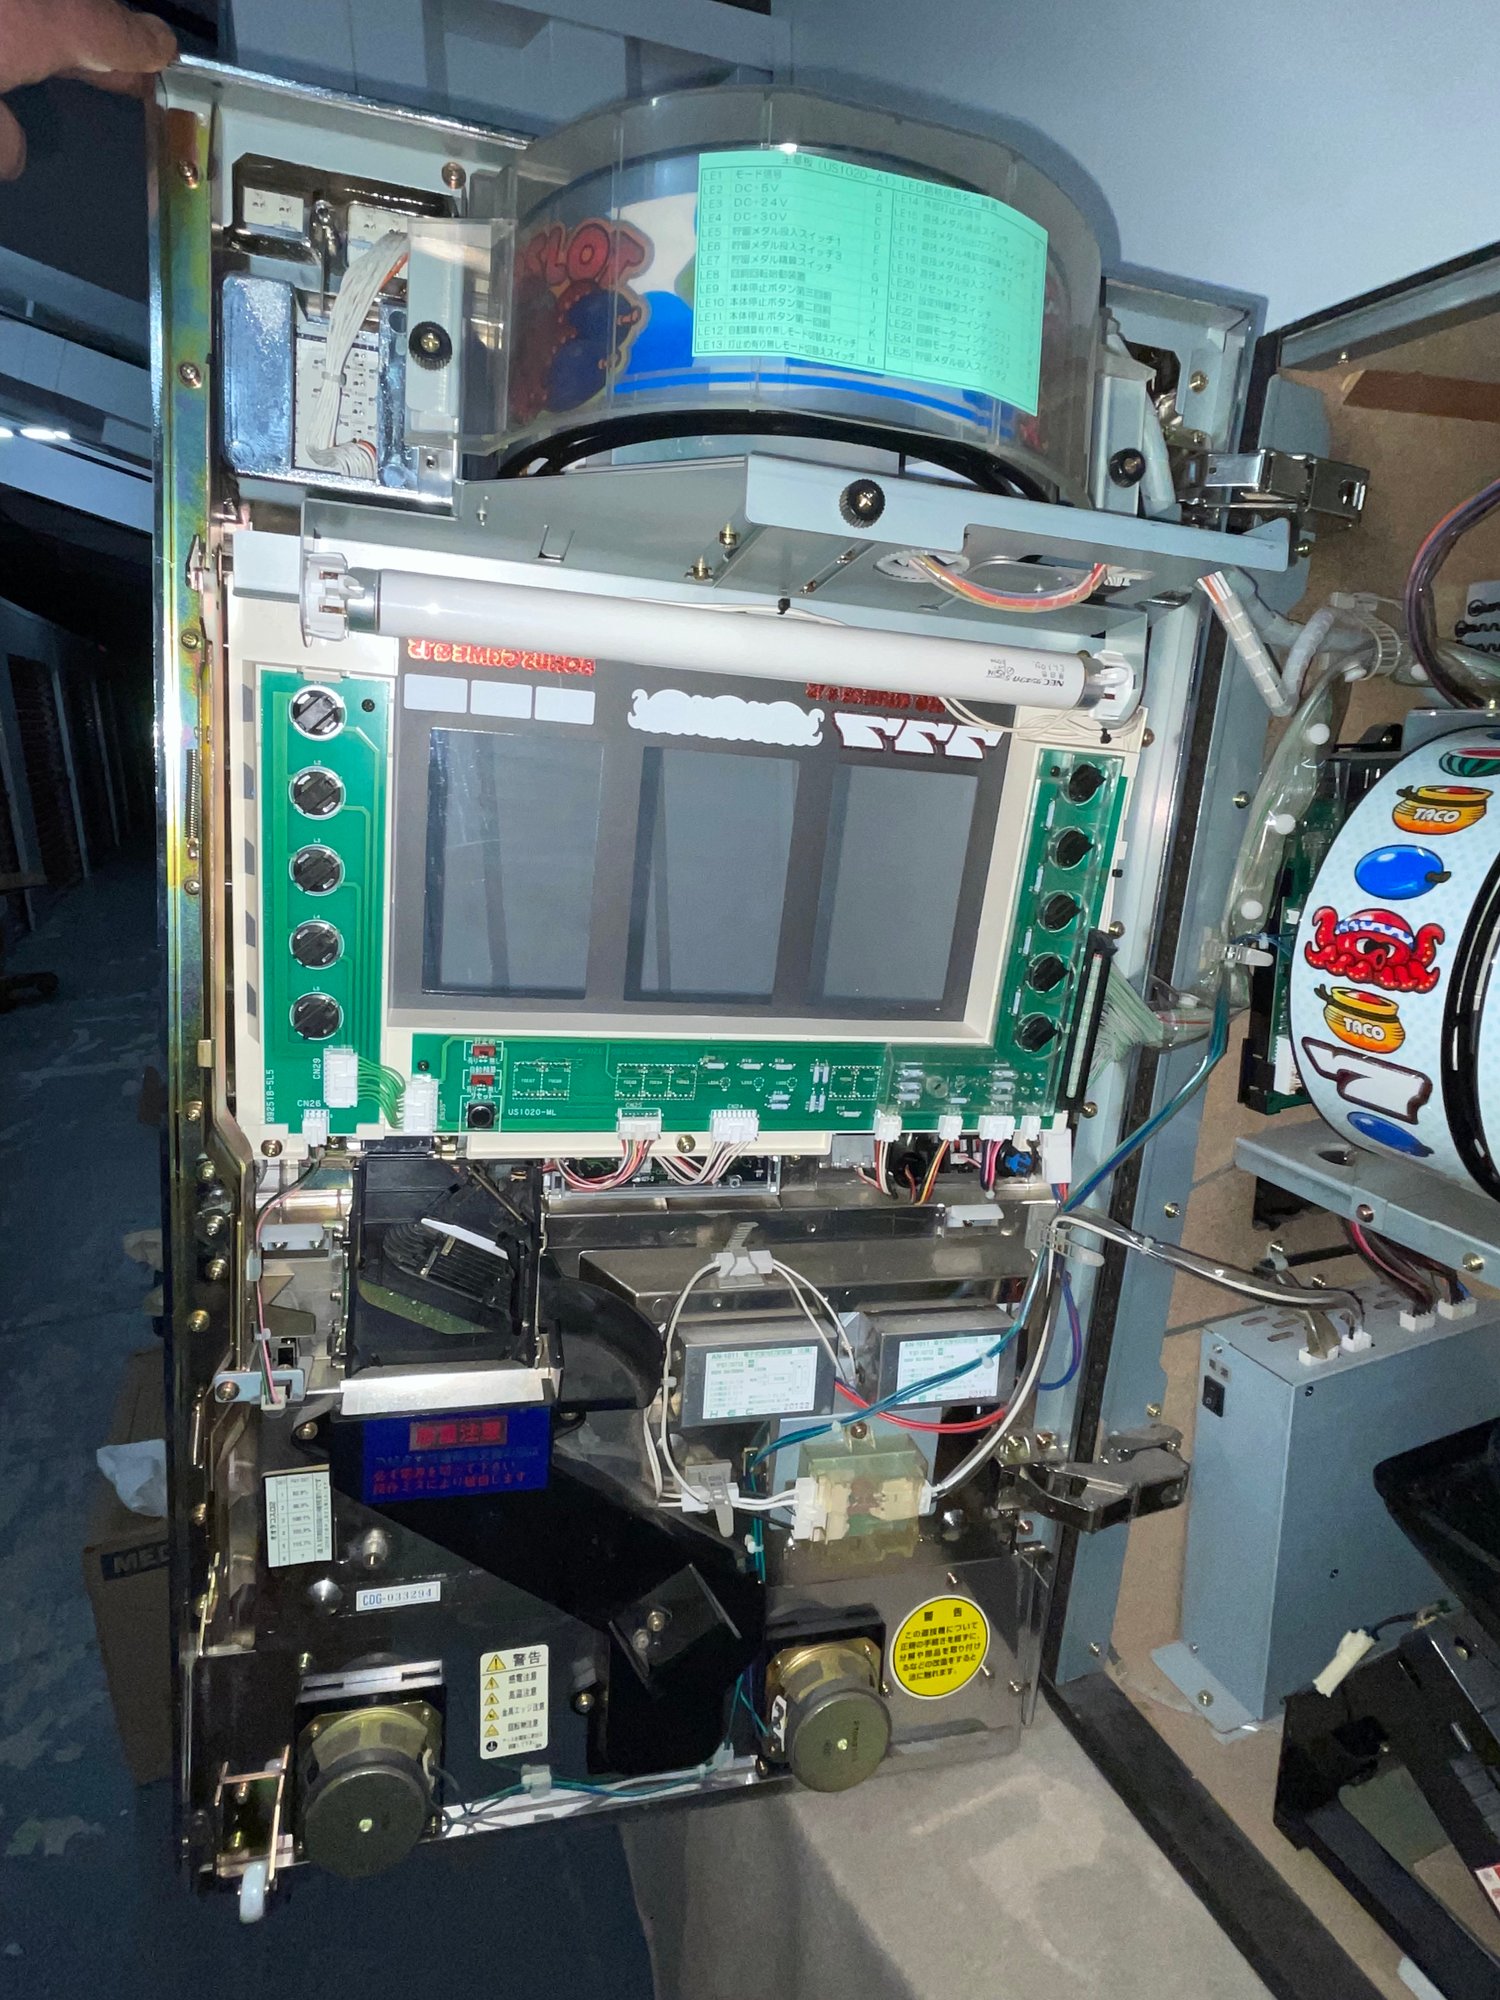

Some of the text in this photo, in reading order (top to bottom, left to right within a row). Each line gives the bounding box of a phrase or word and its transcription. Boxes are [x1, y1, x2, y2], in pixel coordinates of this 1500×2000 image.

[704, 171, 722, 181] LE1
[703, 186, 723, 196] LE2
[702, 200, 722, 210] LE3
[702, 214, 721, 224] LE4
[701, 227, 721, 237] LE5
[700, 241, 720, 251] LE6
[700, 256, 720, 265] LE7
[699, 270, 719, 280] LE8
[699, 284, 719, 294] LE9
[698, 298, 724, 308] LE10
[698, 312, 722, 322] LE11
[697, 326, 723, 336] LE12
[697, 340, 722, 350] LE13
[1413, 807, 1461, 823] TACO
[1343, 1016, 1386, 1041] TACO
[312, 1057, 321, 1080] CN29
[296, 1099, 322, 1108] CN26
[507, 1108, 557, 1117] US1020-ML
[363, 1587, 432, 1606] CDG-033294
[513, 1651, 541, 1667] 警告
